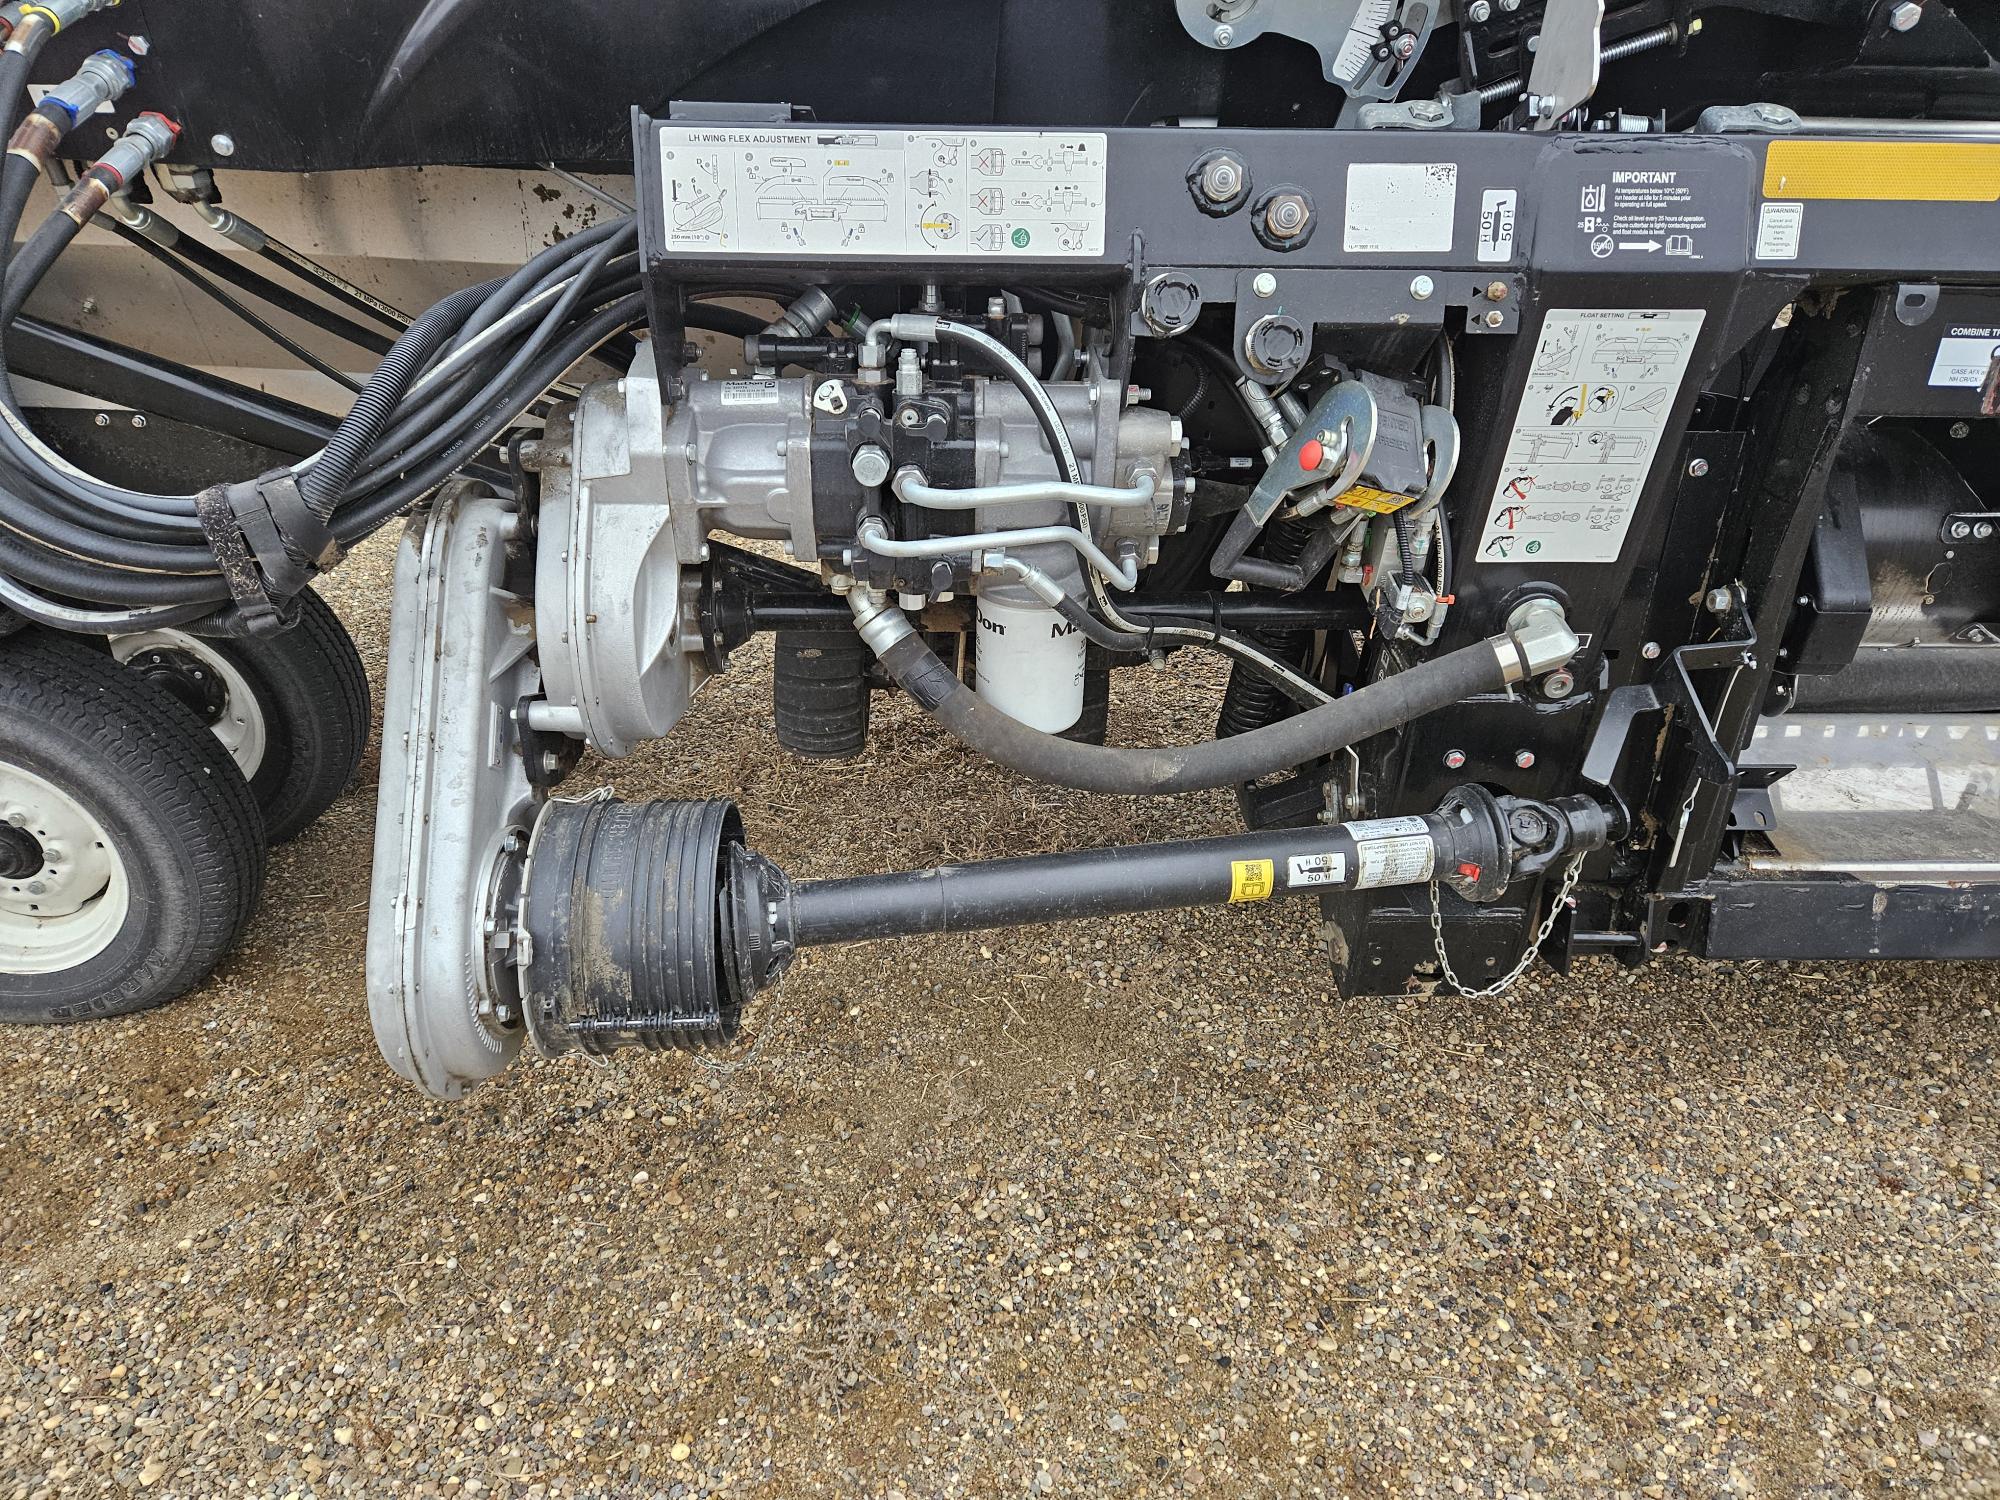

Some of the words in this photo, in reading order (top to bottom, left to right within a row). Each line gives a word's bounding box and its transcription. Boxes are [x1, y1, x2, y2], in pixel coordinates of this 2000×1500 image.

[688, 133, 700, 142] LH
[702, 133, 726, 143] WING
[728, 134, 751, 143] FLEX
[752, 135, 811, 144] ADJUSTMENT
[1612, 171, 1677, 183] IMPORTANT
[1481, 211, 1493, 229] 50
[1501, 223, 1513, 241] 50
[354, 290, 362, 298] 21
[363, 294, 377, 308] MPa
[378, 303, 396, 317] (3000
[1951, 328, 1991, 336] COMBINE
[1315, 856, 1328, 865] 50
[1307, 874, 1320, 882] 50
[48, 948, 166, 1018] KARRIER
